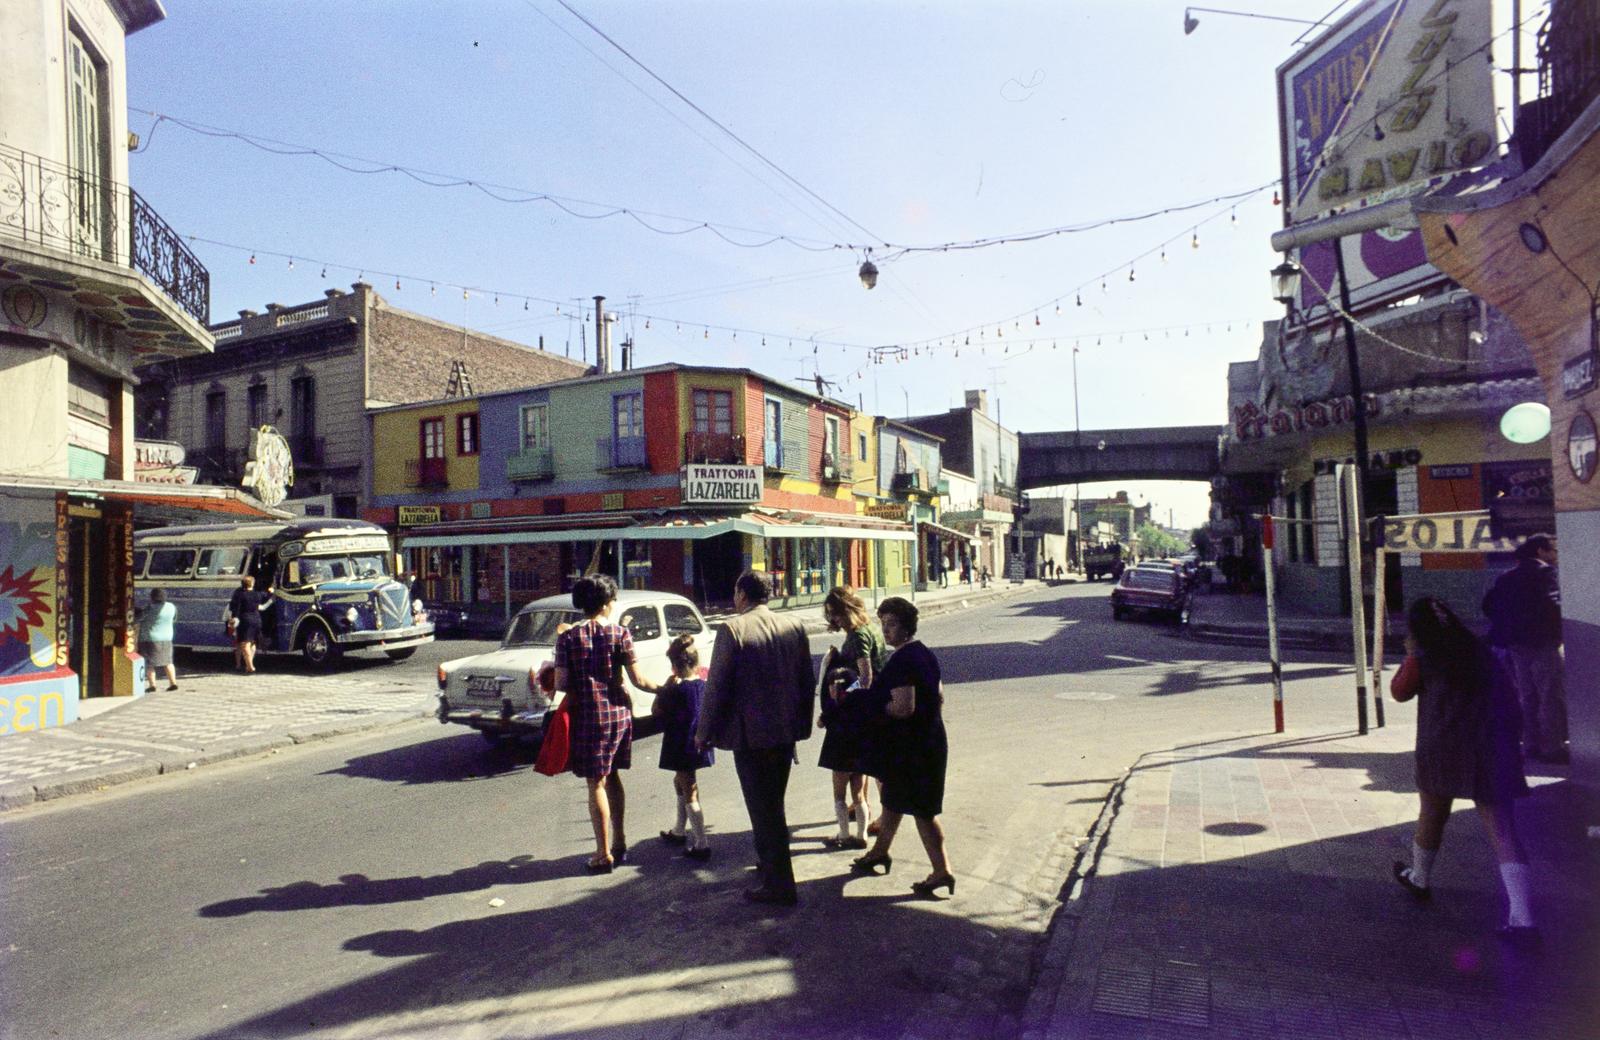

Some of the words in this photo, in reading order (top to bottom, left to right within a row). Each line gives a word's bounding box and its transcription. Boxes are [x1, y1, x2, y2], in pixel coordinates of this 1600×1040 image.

[694, 468, 756, 480] TRATTORIA
[689, 481, 760, 500] LAZZARELLA
[401, 513, 439, 524] LAZZARELLA
[57, 499, 69, 563] TRES
[124, 510, 134, 567] TRES
